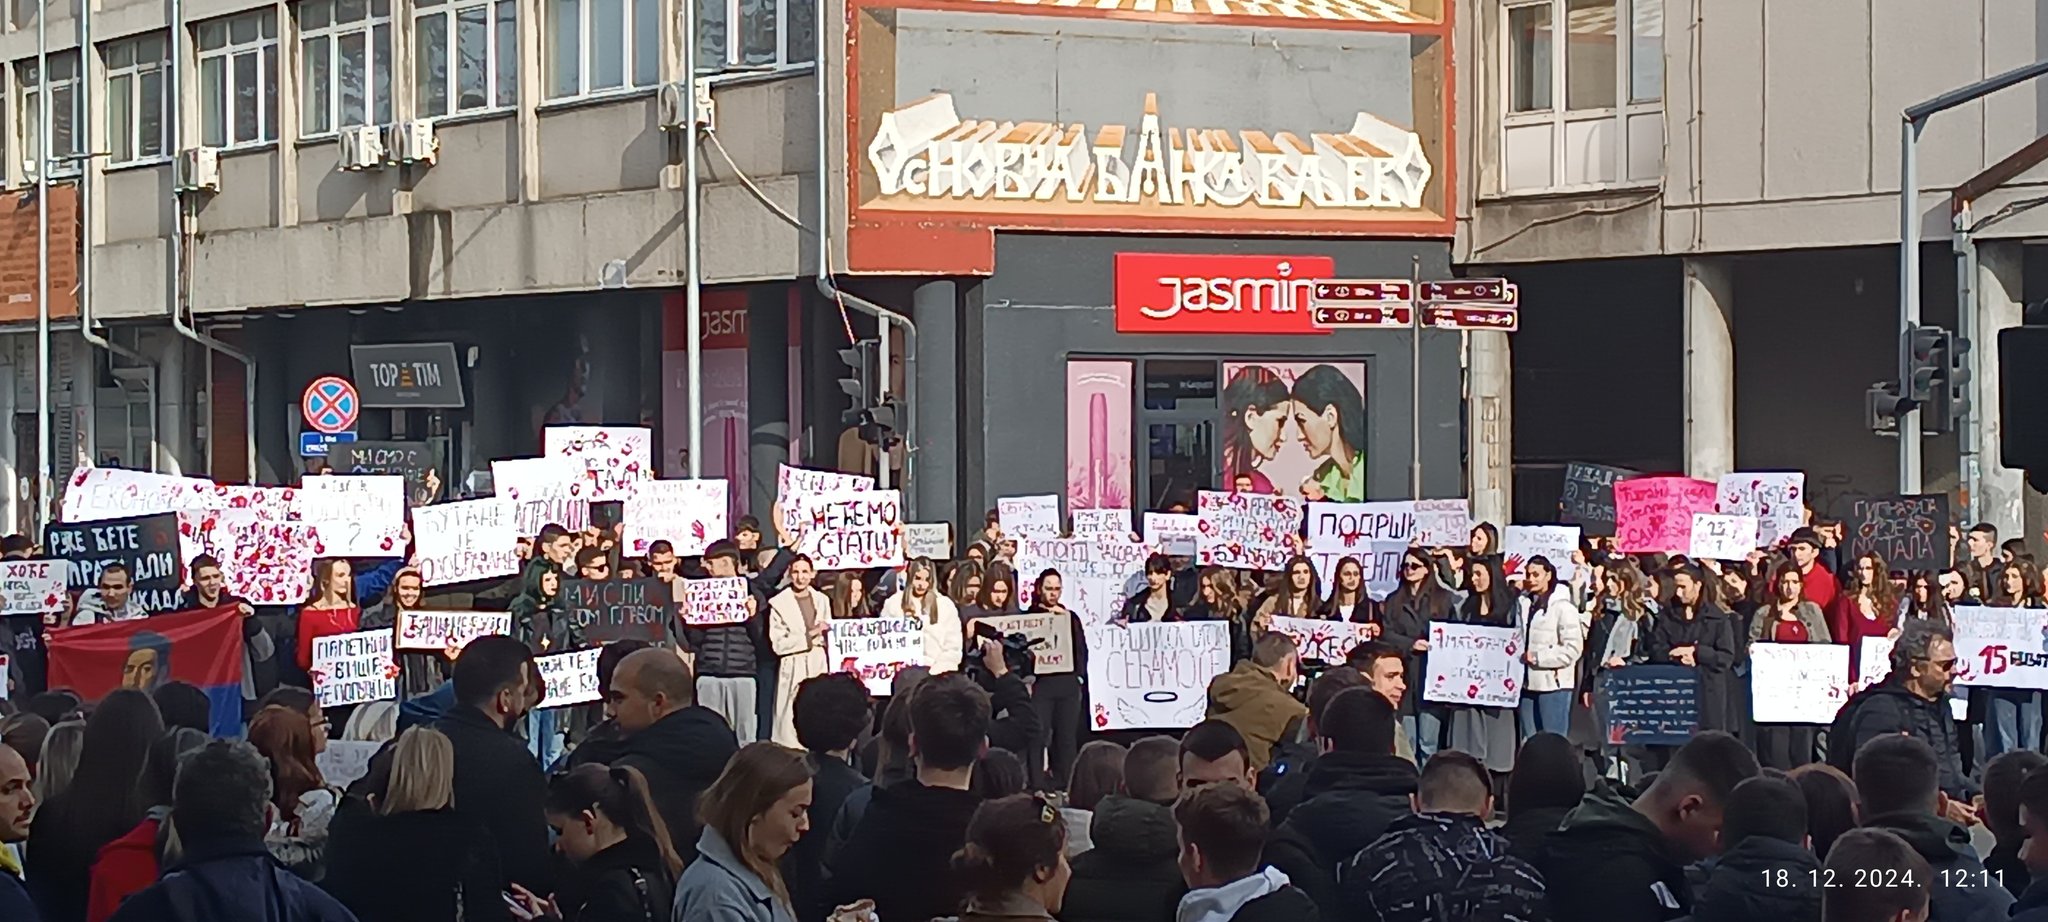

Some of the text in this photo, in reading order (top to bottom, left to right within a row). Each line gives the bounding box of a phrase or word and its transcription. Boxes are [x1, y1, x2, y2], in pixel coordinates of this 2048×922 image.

[369, 362, 442, 388] TOP TIM
[811, 501, 896, 531] НЕЋЕМО
[91, 525, 140, 551] ЋЕТЕ
[135, 553, 174, 582] АЛИ
[565, 582, 644, 606] МИСЛИ
[1978, 645, 2009, 675] 15
